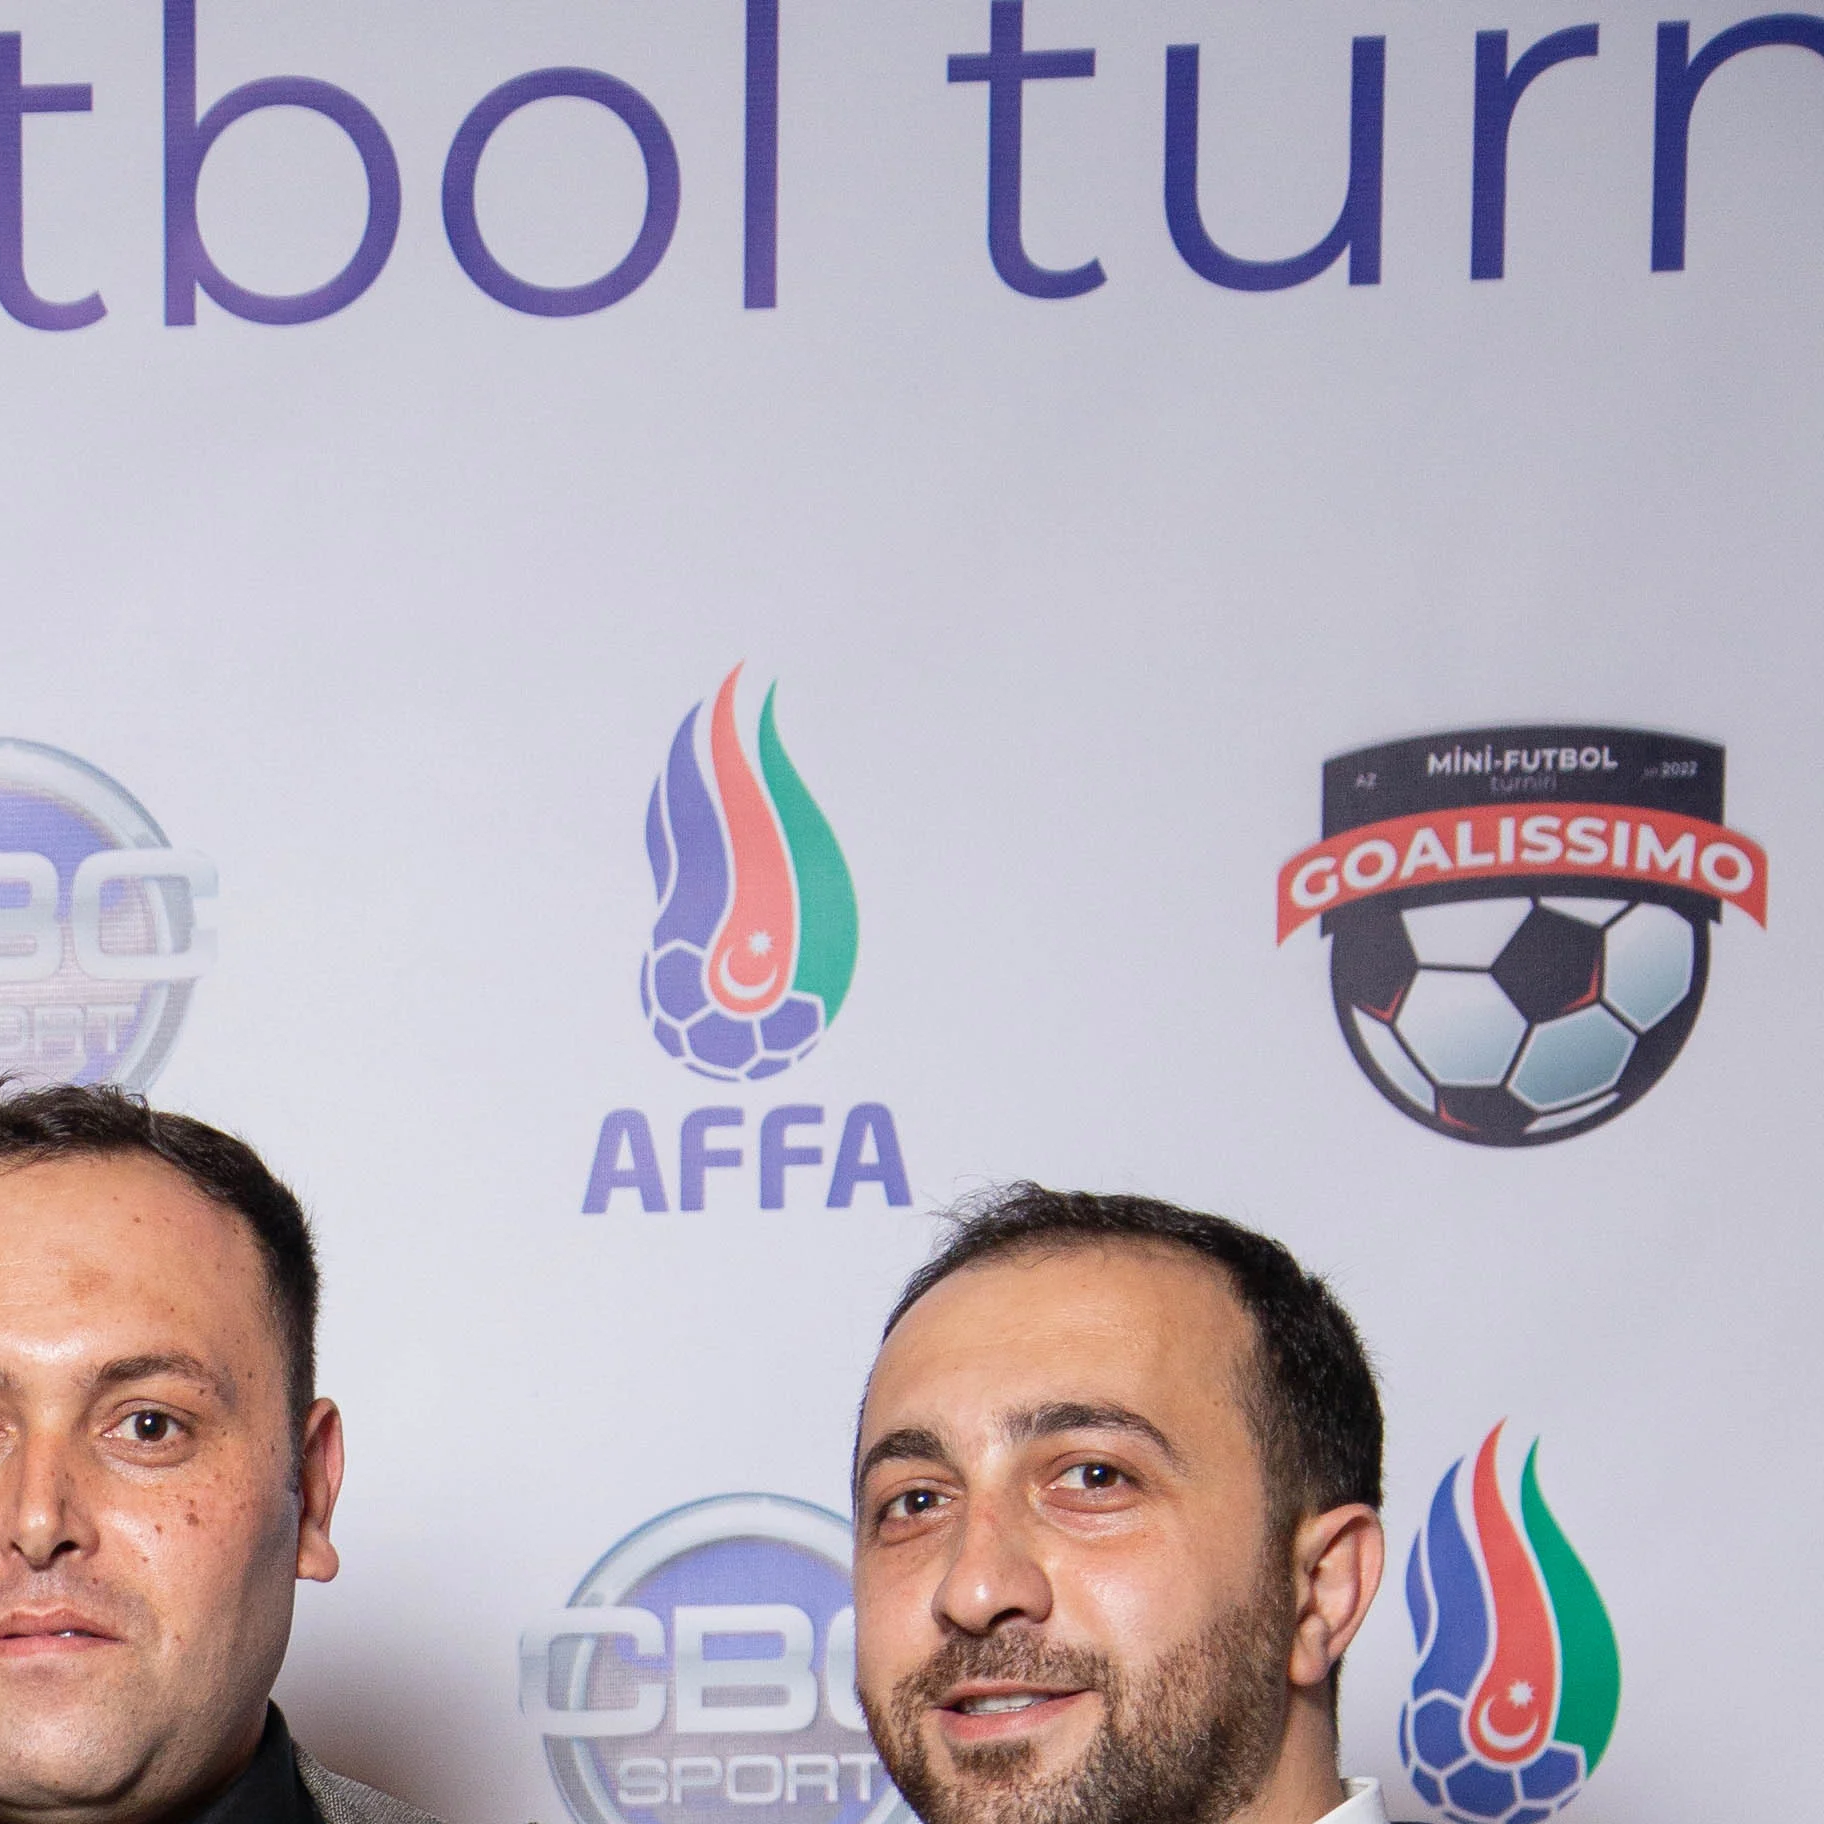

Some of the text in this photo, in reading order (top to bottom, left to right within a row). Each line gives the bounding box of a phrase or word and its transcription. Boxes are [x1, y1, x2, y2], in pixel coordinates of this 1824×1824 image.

[1290, 815, 1755, 909] GOALISSIMO
[581, 1101, 913, 1214] AFFA
[519, 1602, 868, 1738] CB
